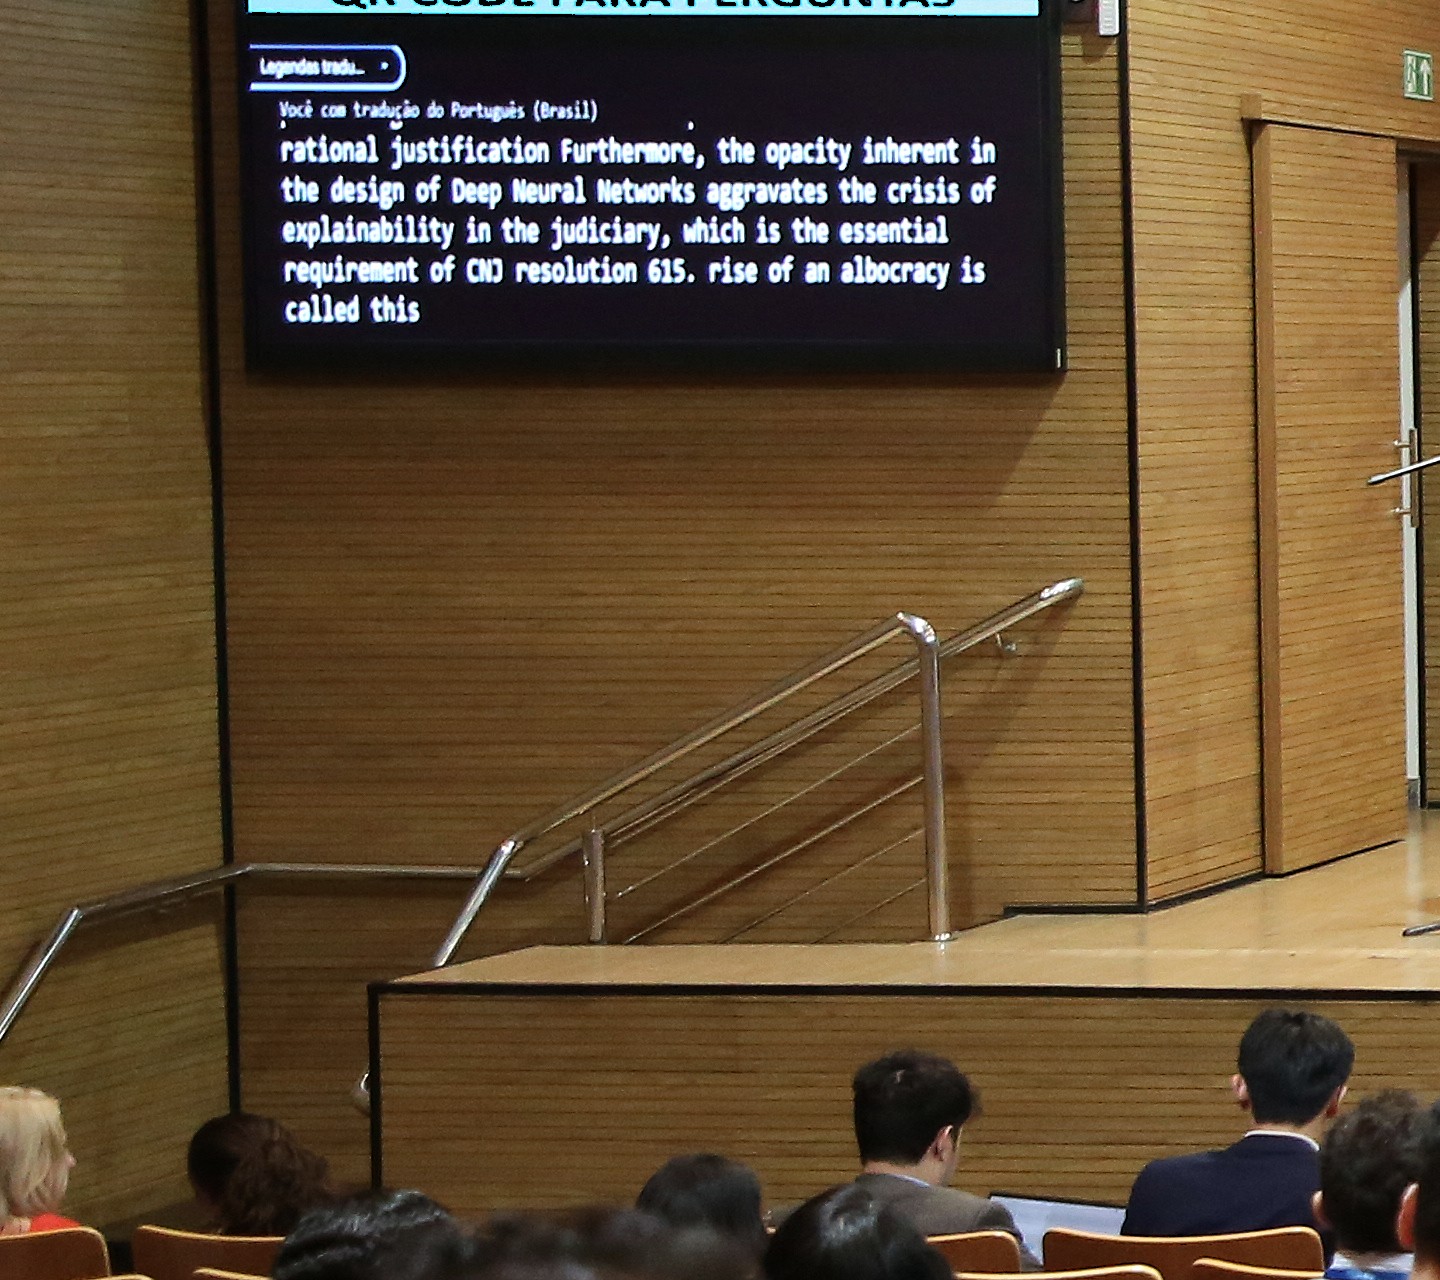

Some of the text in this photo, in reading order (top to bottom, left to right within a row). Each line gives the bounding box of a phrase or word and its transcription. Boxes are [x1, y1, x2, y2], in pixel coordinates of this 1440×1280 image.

[260, 57, 320, 79] Legendas
[279, 99, 597, 122] Você com tradução do Português (Brasil)
[281, 133, 995, 171] rational justification Furthermore, the opacity inherent in
[281, 175, 996, 211] the design of Deep Neural Networks aggravates the crisis of
[282, 215, 949, 251] explainability in the judiciary, which is the essential
[284, 255, 985, 291] requirement of CNJ resolution 615. rise of an albocracy is
[285, 295, 420, 323] called this
